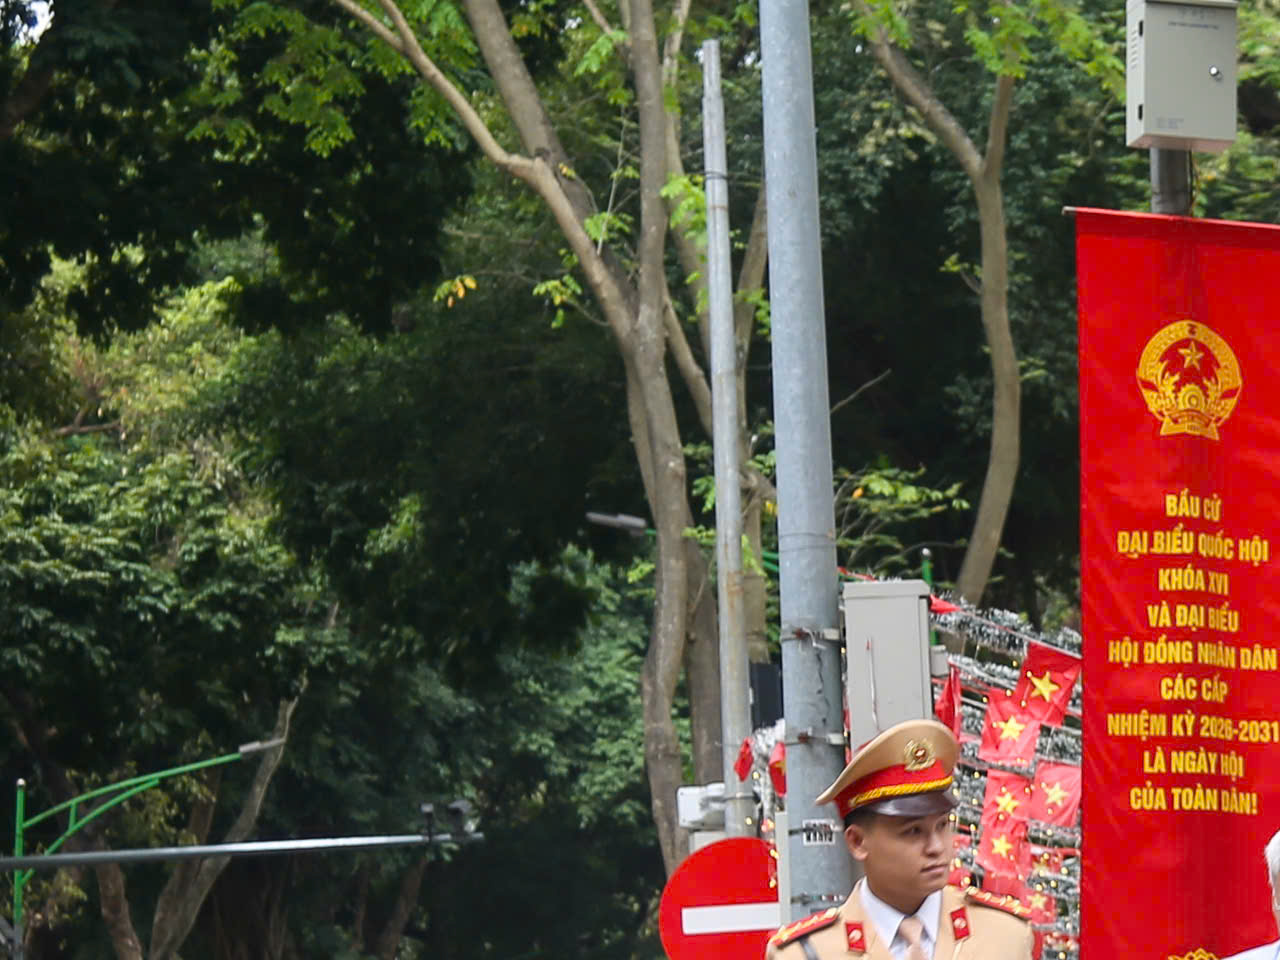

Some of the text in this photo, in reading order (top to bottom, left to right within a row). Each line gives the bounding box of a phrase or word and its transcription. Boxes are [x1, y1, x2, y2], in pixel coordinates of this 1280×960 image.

[1117, 530, 1148, 559] ĐẠI
[1198, 529, 1235, 560] QUỐC
[1238, 535, 1269, 567] HỘI
[1158, 563, 1229, 595] KHÓA XVI
[1147, 600, 1172, 627] VÀ
[1175, 604, 1205, 632] ĐẠI
[1108, 636, 1139, 668] HỘI
[1198, 640, 1236, 669] NHÂN
[1240, 643, 1278, 671] DÂN
[1161, 672, 1229, 703] CÁC CẤP
[1107, 709, 1280, 743] NHIỆM KỲ 2026-2031
[1143, 746, 1244, 782] LÀ NGÀY HỘI
[1129, 780, 1167, 811] CỦA
[1171, 783, 1218, 811] TOÀN
